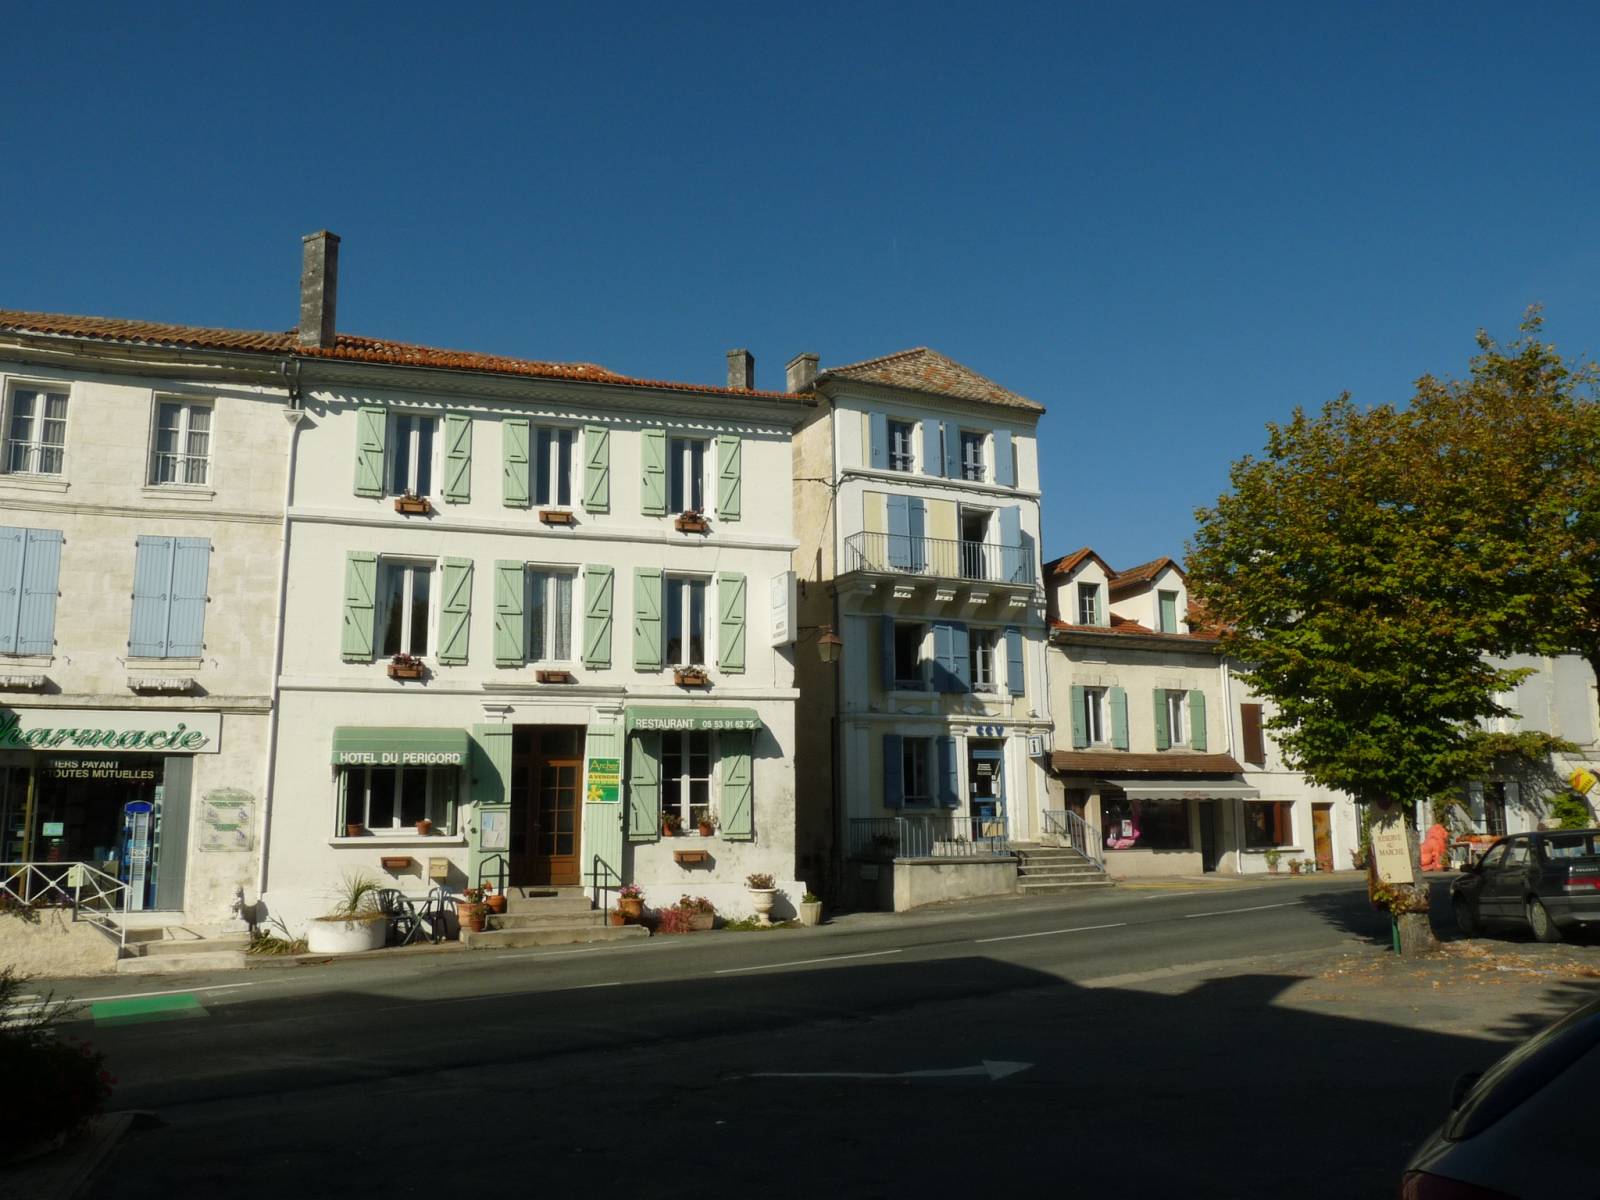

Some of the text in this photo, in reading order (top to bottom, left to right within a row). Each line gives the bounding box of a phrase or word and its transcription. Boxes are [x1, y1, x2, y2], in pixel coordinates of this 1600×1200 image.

[635, 718, 695, 729] RESTAURANT
[702, 720, 712, 729] 05
[714, 720, 723, 729] 53
[0, 711, 209, 749] harmacie
[340, 752, 461, 764] HOTEL DU PERIGORD
[48, 760, 119, 769] IERS PAYANT
[48, 769, 155, 779] OUTES MUTUELLES
